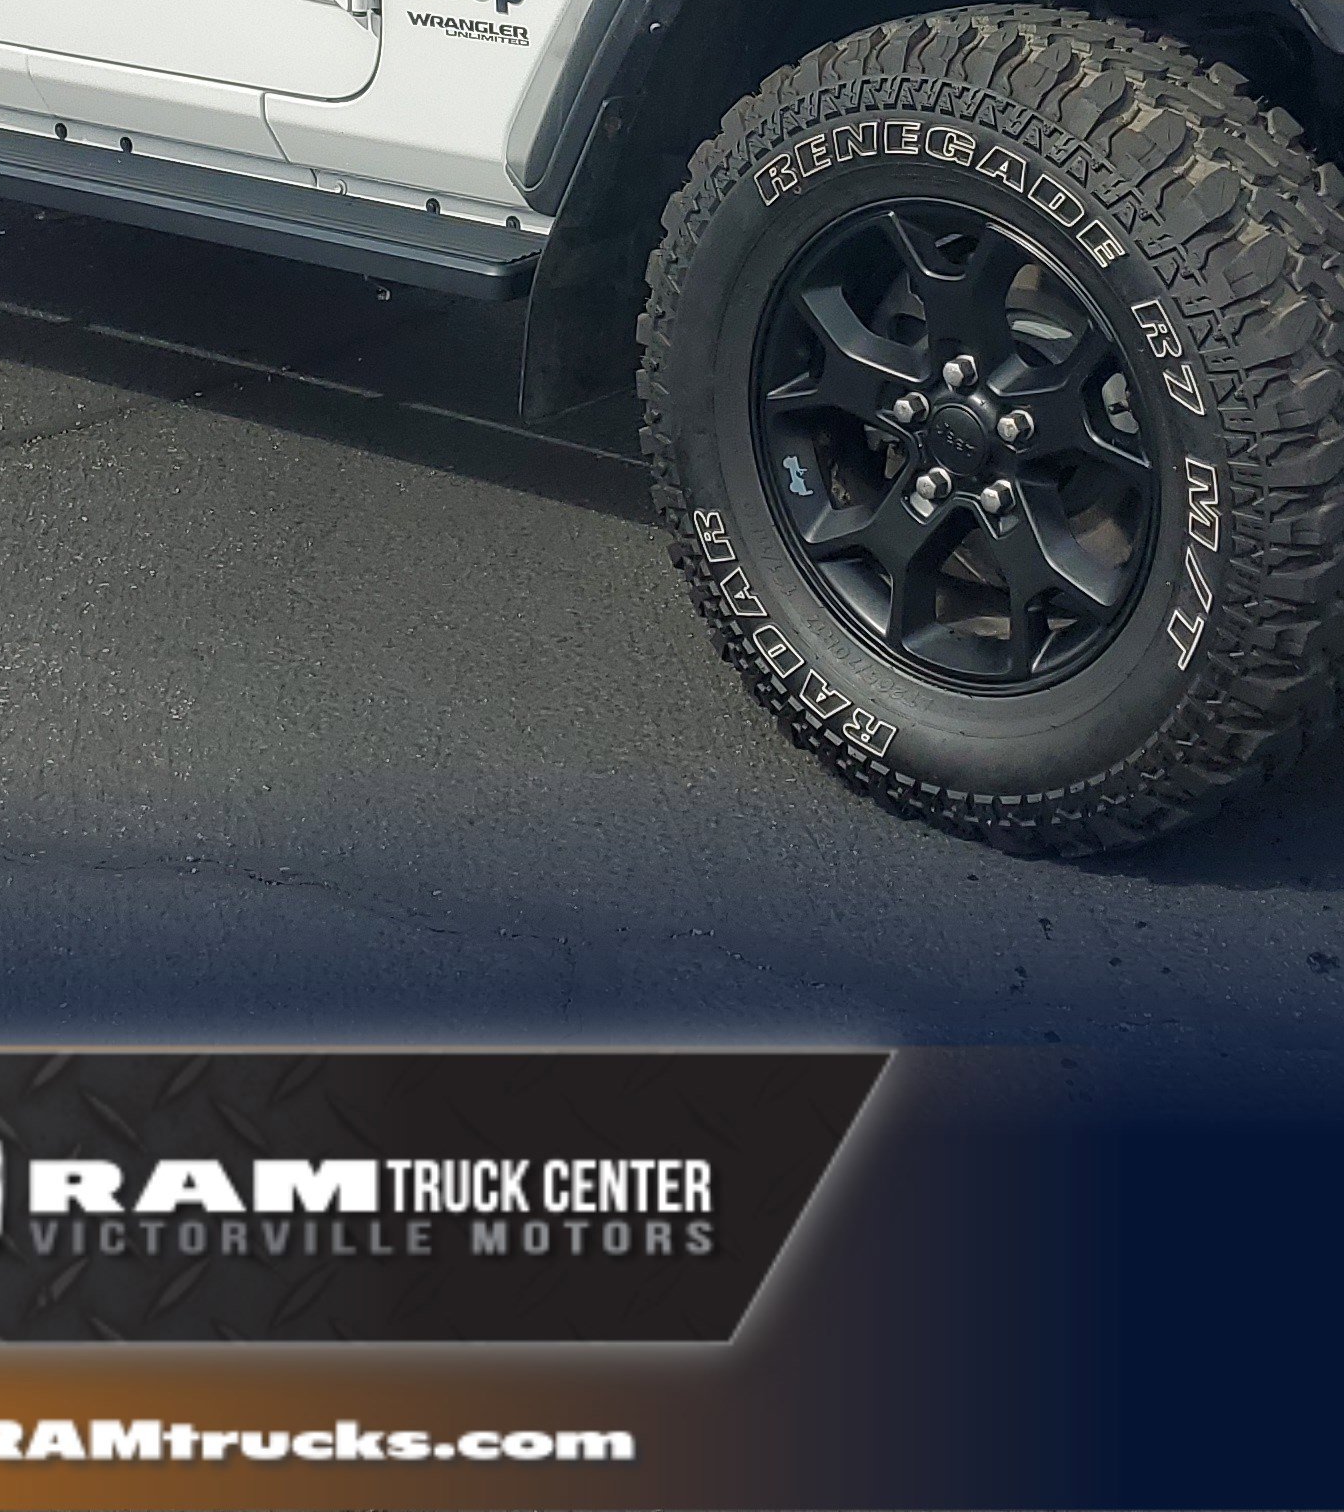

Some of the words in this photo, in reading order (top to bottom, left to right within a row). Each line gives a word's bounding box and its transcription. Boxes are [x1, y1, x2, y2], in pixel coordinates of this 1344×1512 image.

[406, 10, 530, 41] WRANGLER
[445, 29, 530, 47] UNLIMITED
[753, 119, 1126, 270] RENEGADE
[1131, 297, 1205, 417] R7
[1165, 456, 1221, 672] M/T
[693, 507, 899, 759] RADAR
